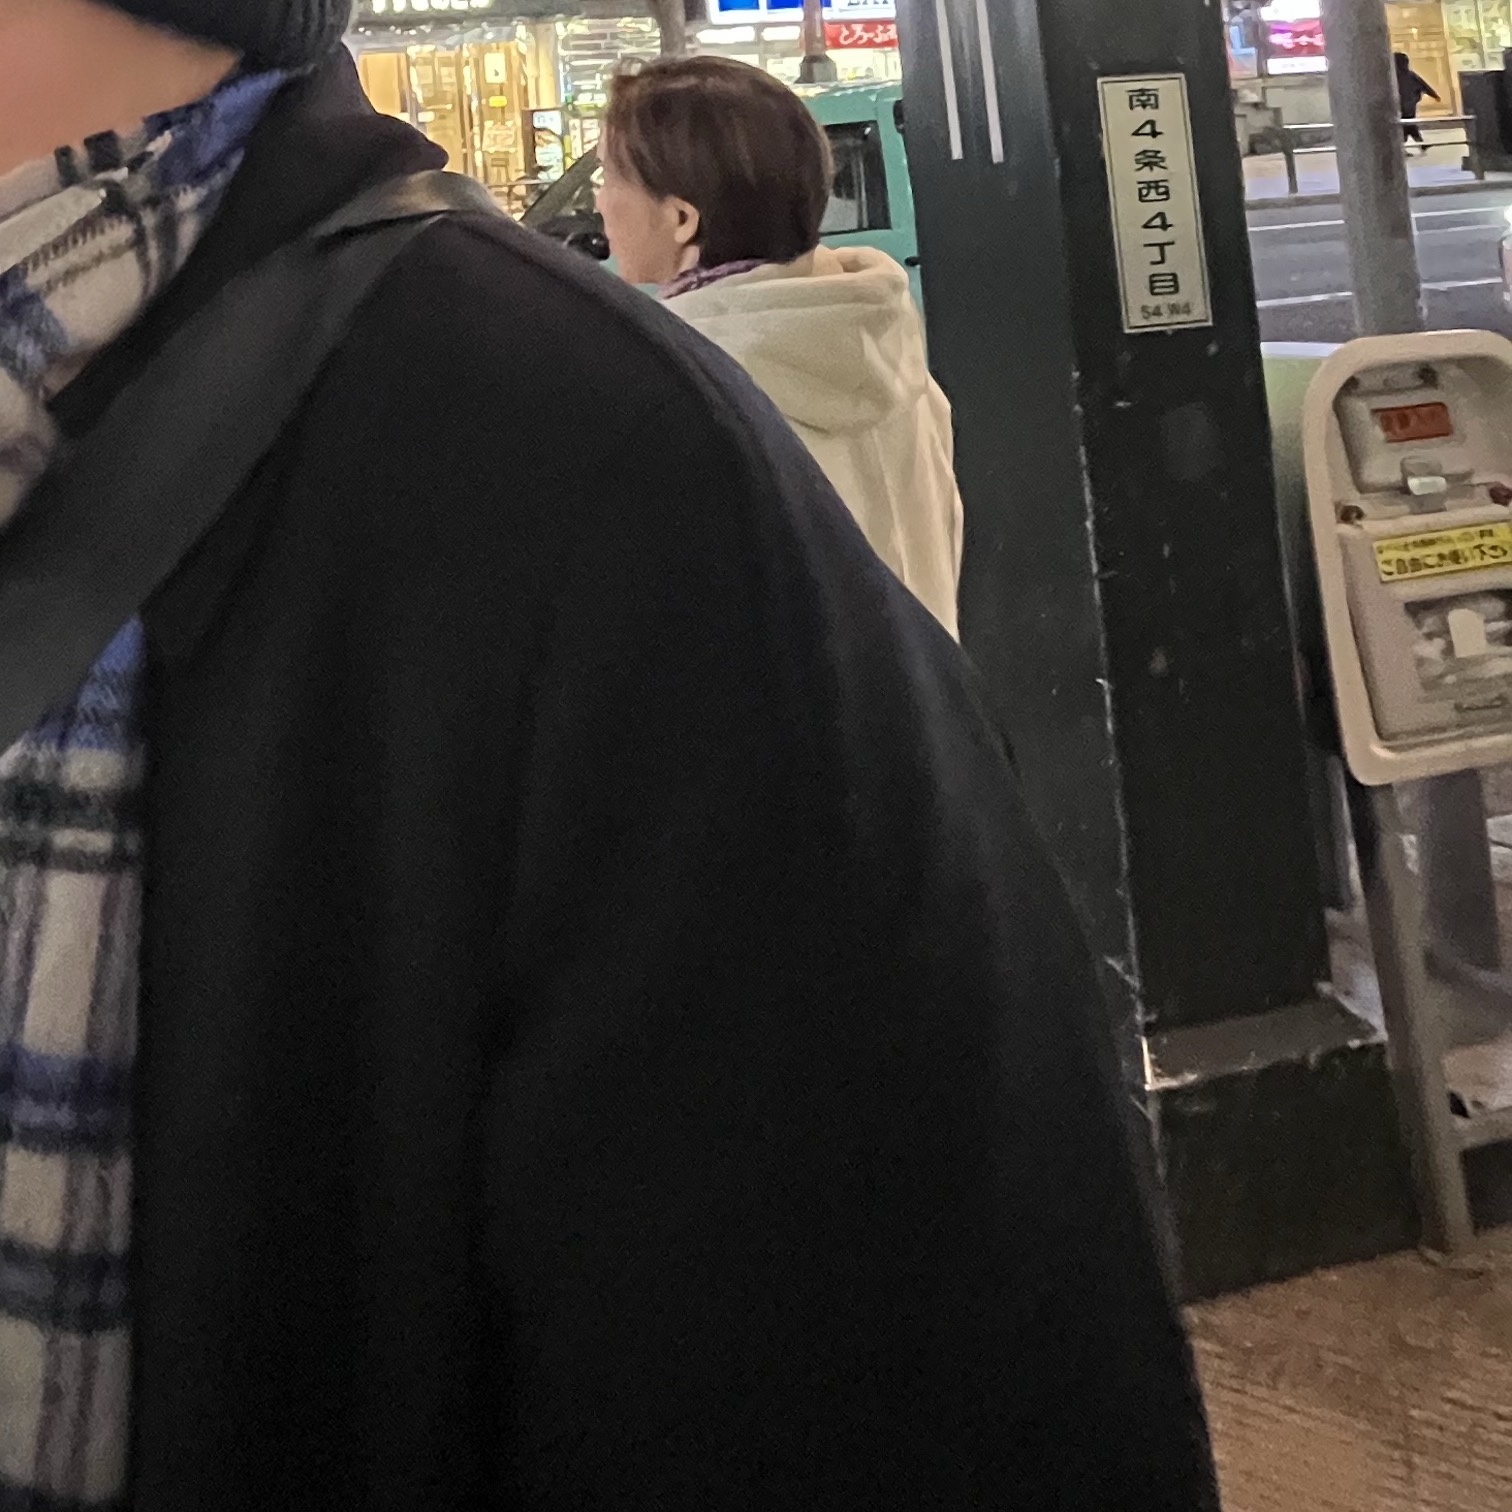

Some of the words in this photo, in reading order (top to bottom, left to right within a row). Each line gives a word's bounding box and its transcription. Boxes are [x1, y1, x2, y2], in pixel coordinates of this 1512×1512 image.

[1125, 88, 1180, 296] 南4条西4丁目
